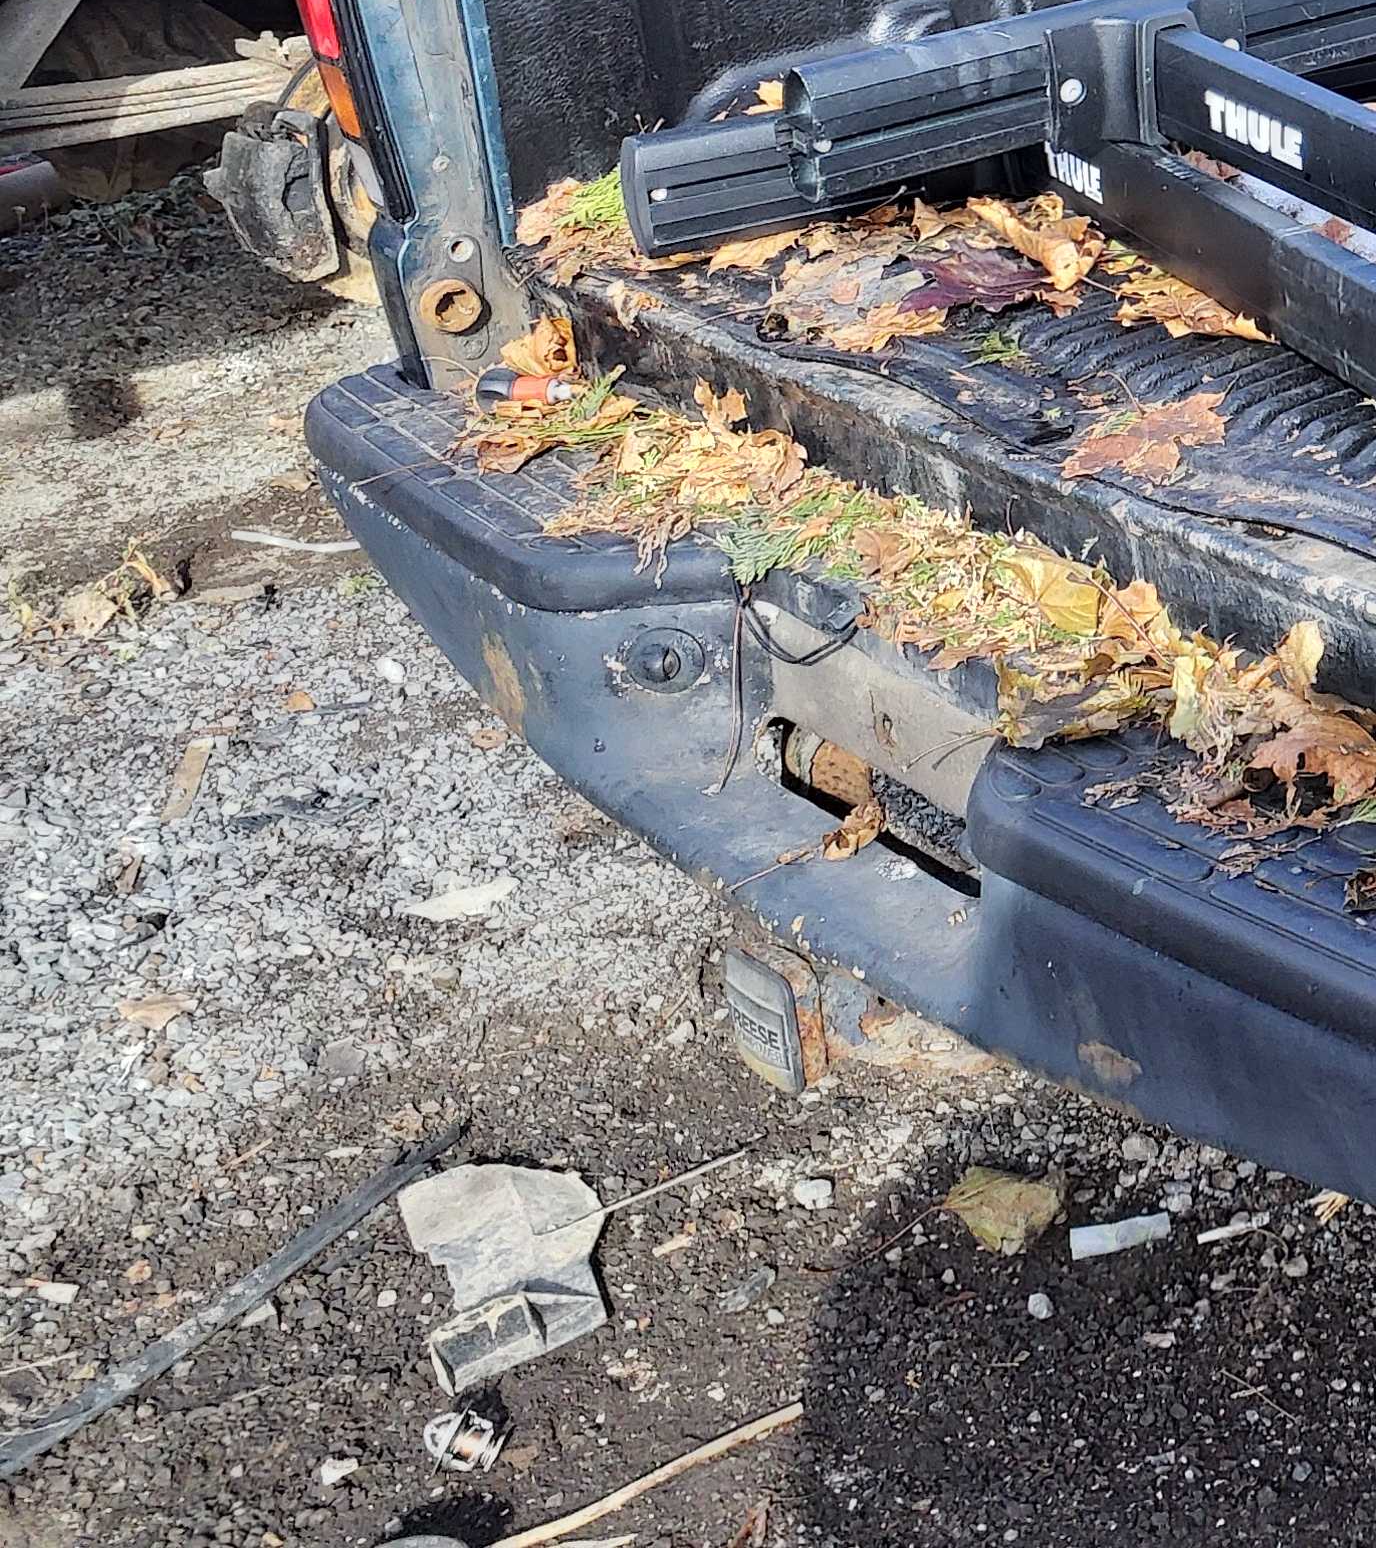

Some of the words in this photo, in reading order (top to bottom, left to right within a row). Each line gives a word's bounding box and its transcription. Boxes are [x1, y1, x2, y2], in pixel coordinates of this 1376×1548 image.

[1205, 89, 1304, 170] THULE
[1044, 142, 1104, 205] THULE
[733, 1007, 781, 1051] REESE
